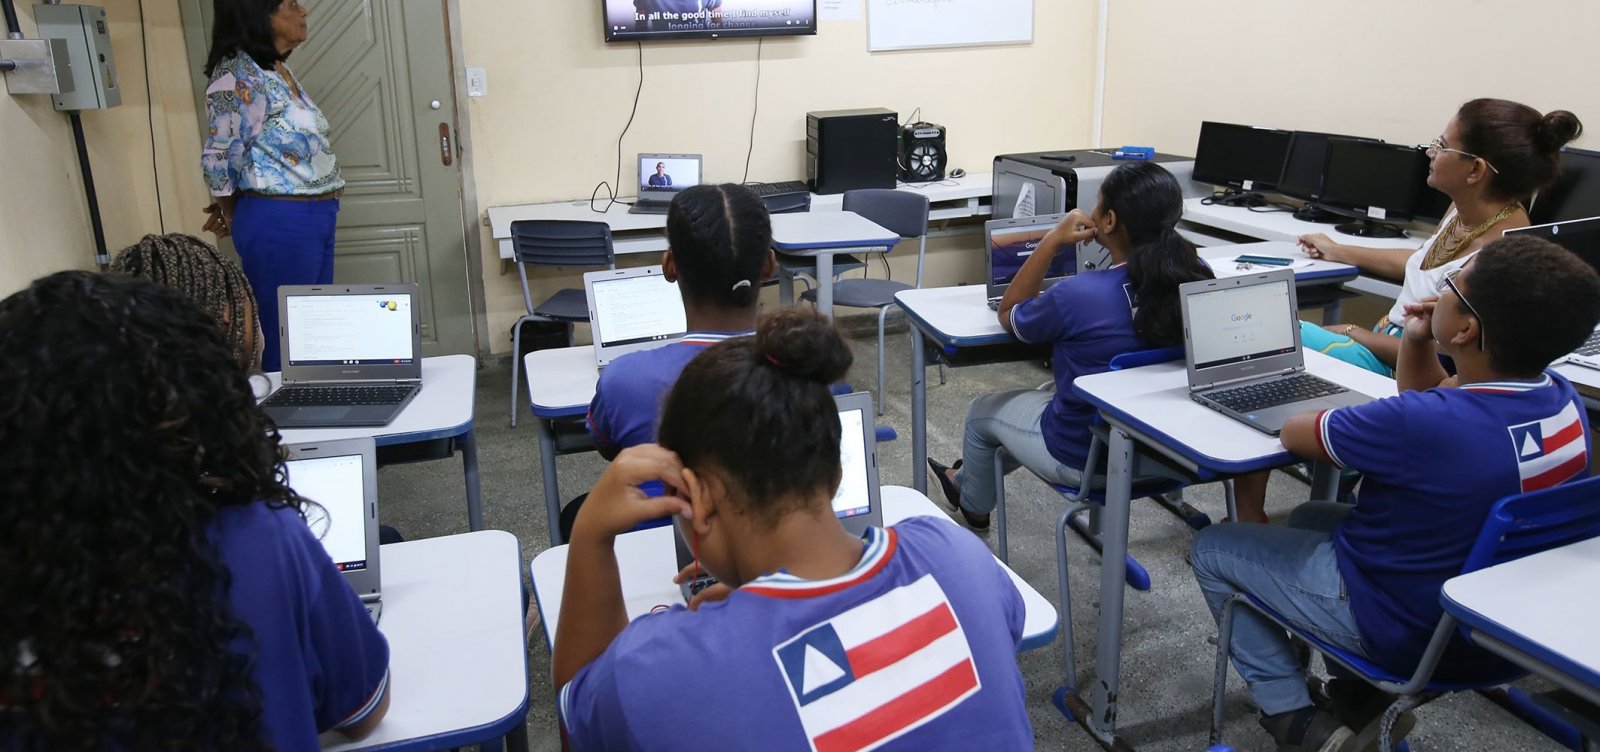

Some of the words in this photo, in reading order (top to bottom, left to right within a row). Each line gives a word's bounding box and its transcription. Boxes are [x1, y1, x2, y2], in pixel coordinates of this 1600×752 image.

[634, 12, 646, 21] In
[648, 12, 660, 20] all
[662, 11, 679, 20] the
[681, 10, 705, 21] good
[708, 8, 729, 19] time
[739, 9, 757, 18] find
[759, 8, 791, 19] myself
[706, 21, 720, 29] for
[1231, 312, 1252, 322] Google
